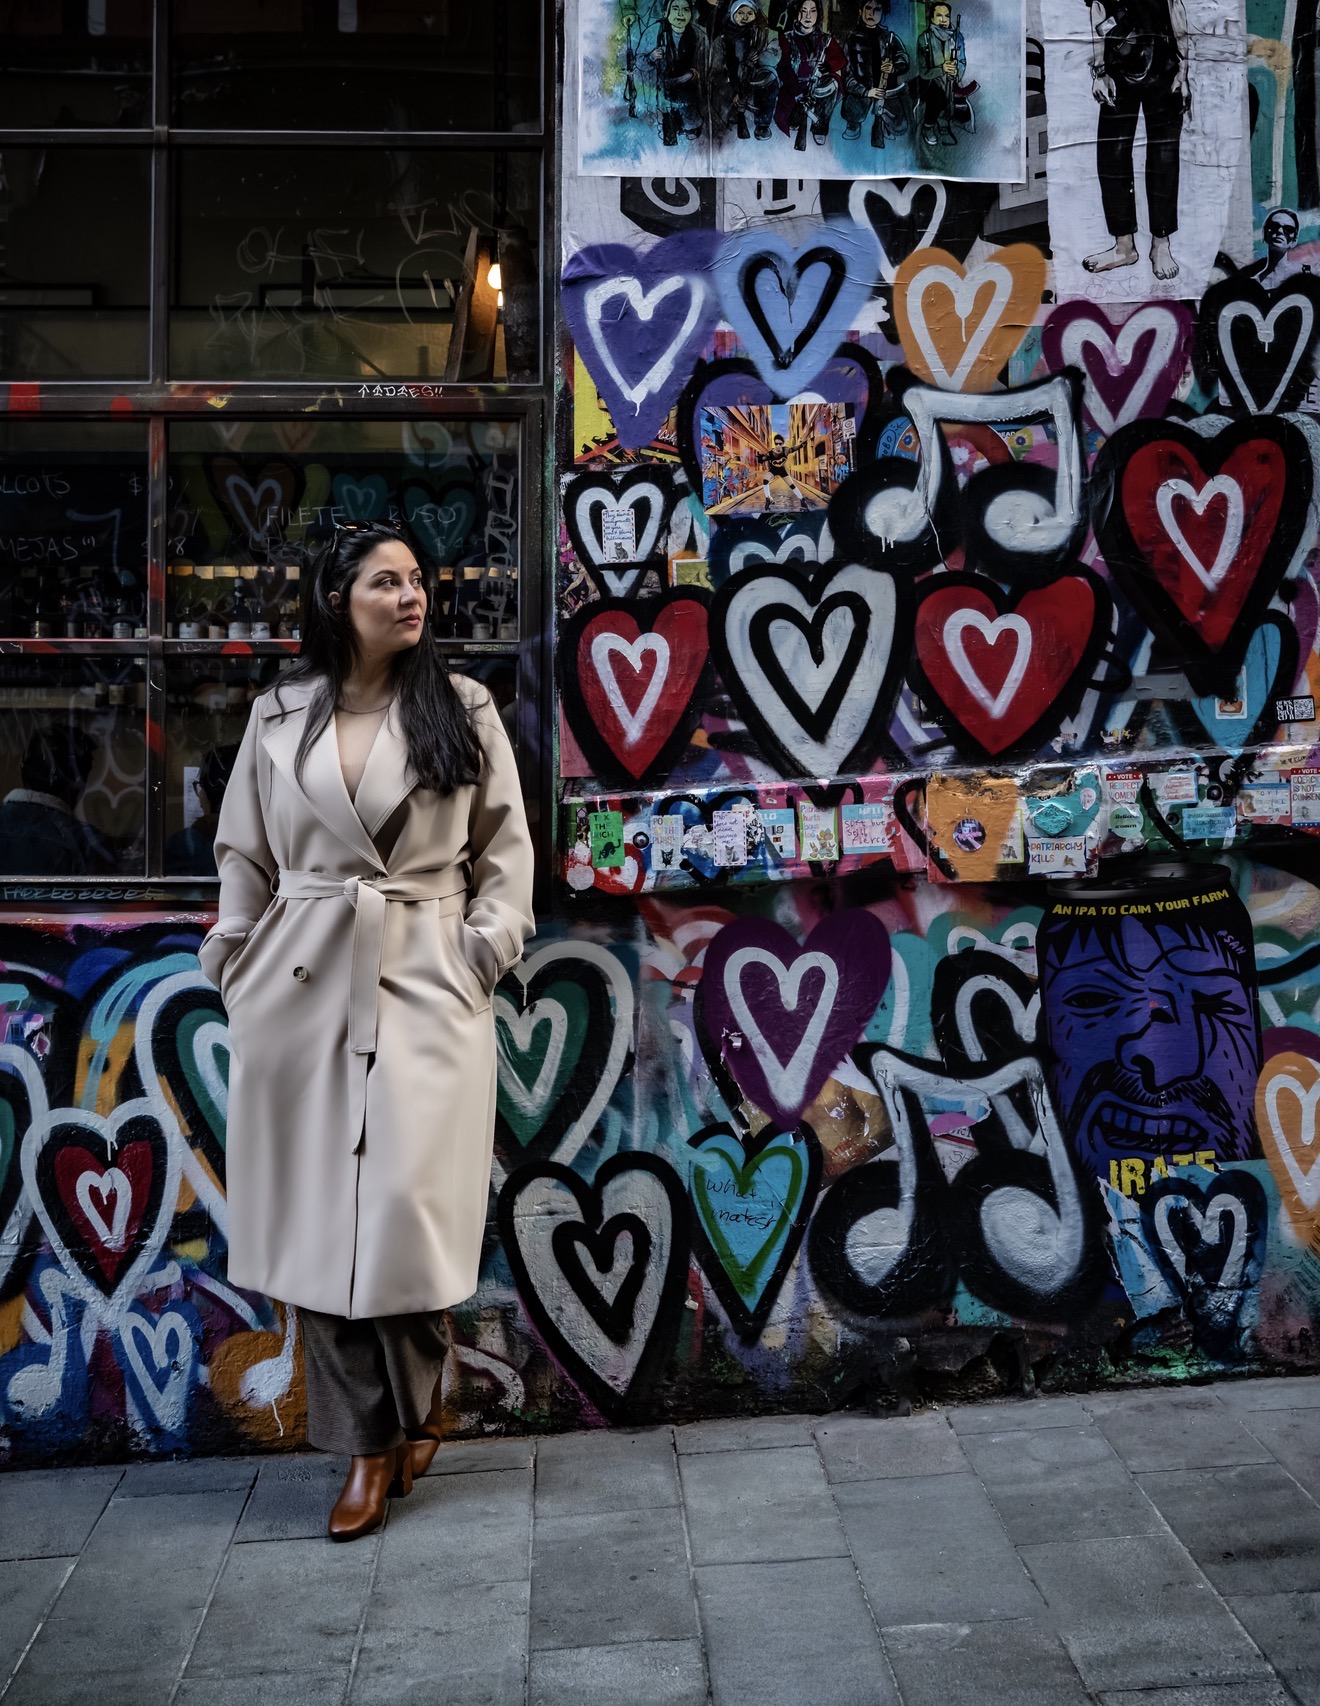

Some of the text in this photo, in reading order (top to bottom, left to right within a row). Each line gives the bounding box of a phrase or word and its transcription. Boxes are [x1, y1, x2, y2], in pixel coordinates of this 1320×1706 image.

[267, 504, 347, 527] FILETE
[1109, 782, 1140, 790] RESPECT
[1292, 793, 1320, 801] CONSEN
[859, 807, 884, 815] HELL
[593, 814, 610, 822] TX
[1030, 842, 1083, 852] PATRIARCHY
[1031, 855, 1055, 863] KILLS
[1052, 904, 1072, 915] AN
[1075, 906, 1097, 916] IPA
[1101, 906, 1117, 915] TO
[1154, 898, 1191, 913] YOUR
[1192, 888, 1230, 907] FARM
[706, 1178, 757, 1200] What
